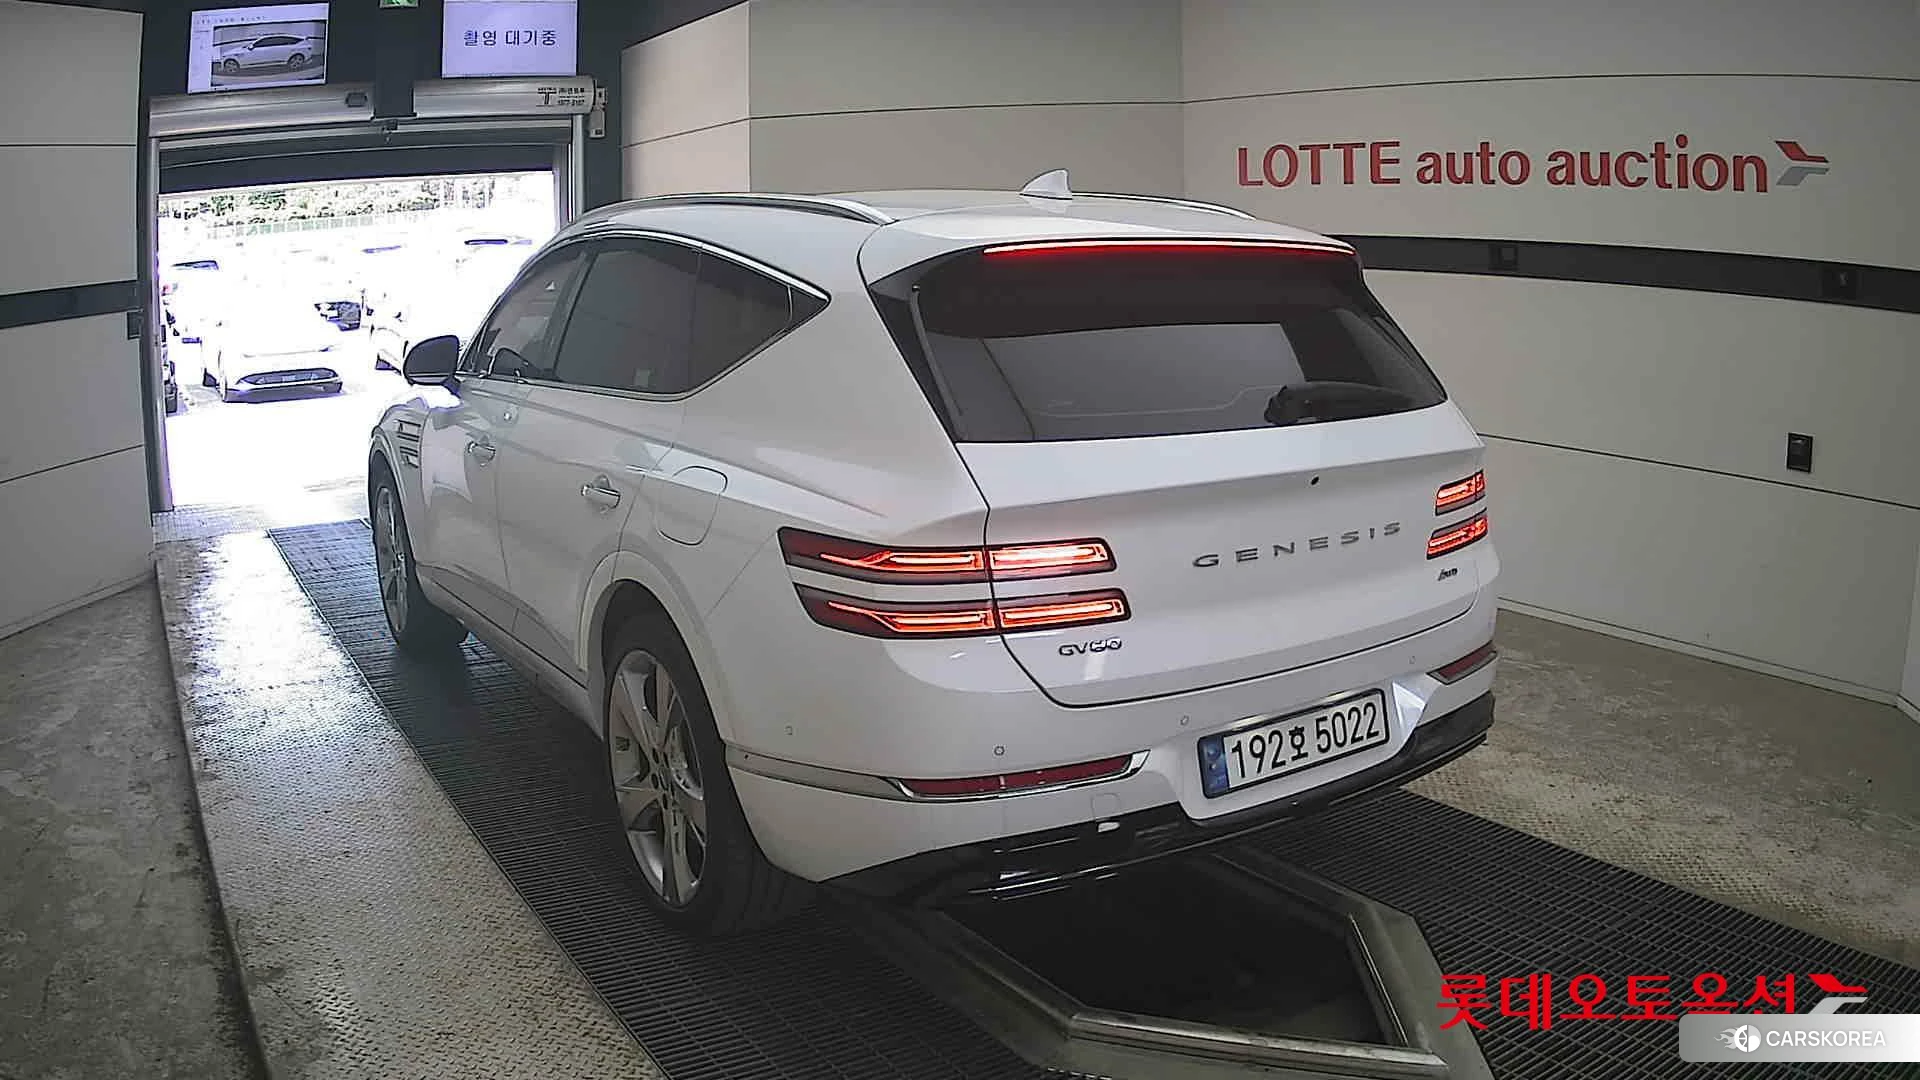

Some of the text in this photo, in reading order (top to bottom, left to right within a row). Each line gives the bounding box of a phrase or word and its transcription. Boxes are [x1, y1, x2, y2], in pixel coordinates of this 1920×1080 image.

[463, 29, 557, 47] 촬영 대기중
[1237, 134, 1767, 193] LOTTE auto auction
[1192, 522, 1401, 568] GENESIS
[1231, 702, 1380, 779] 192호 5022
